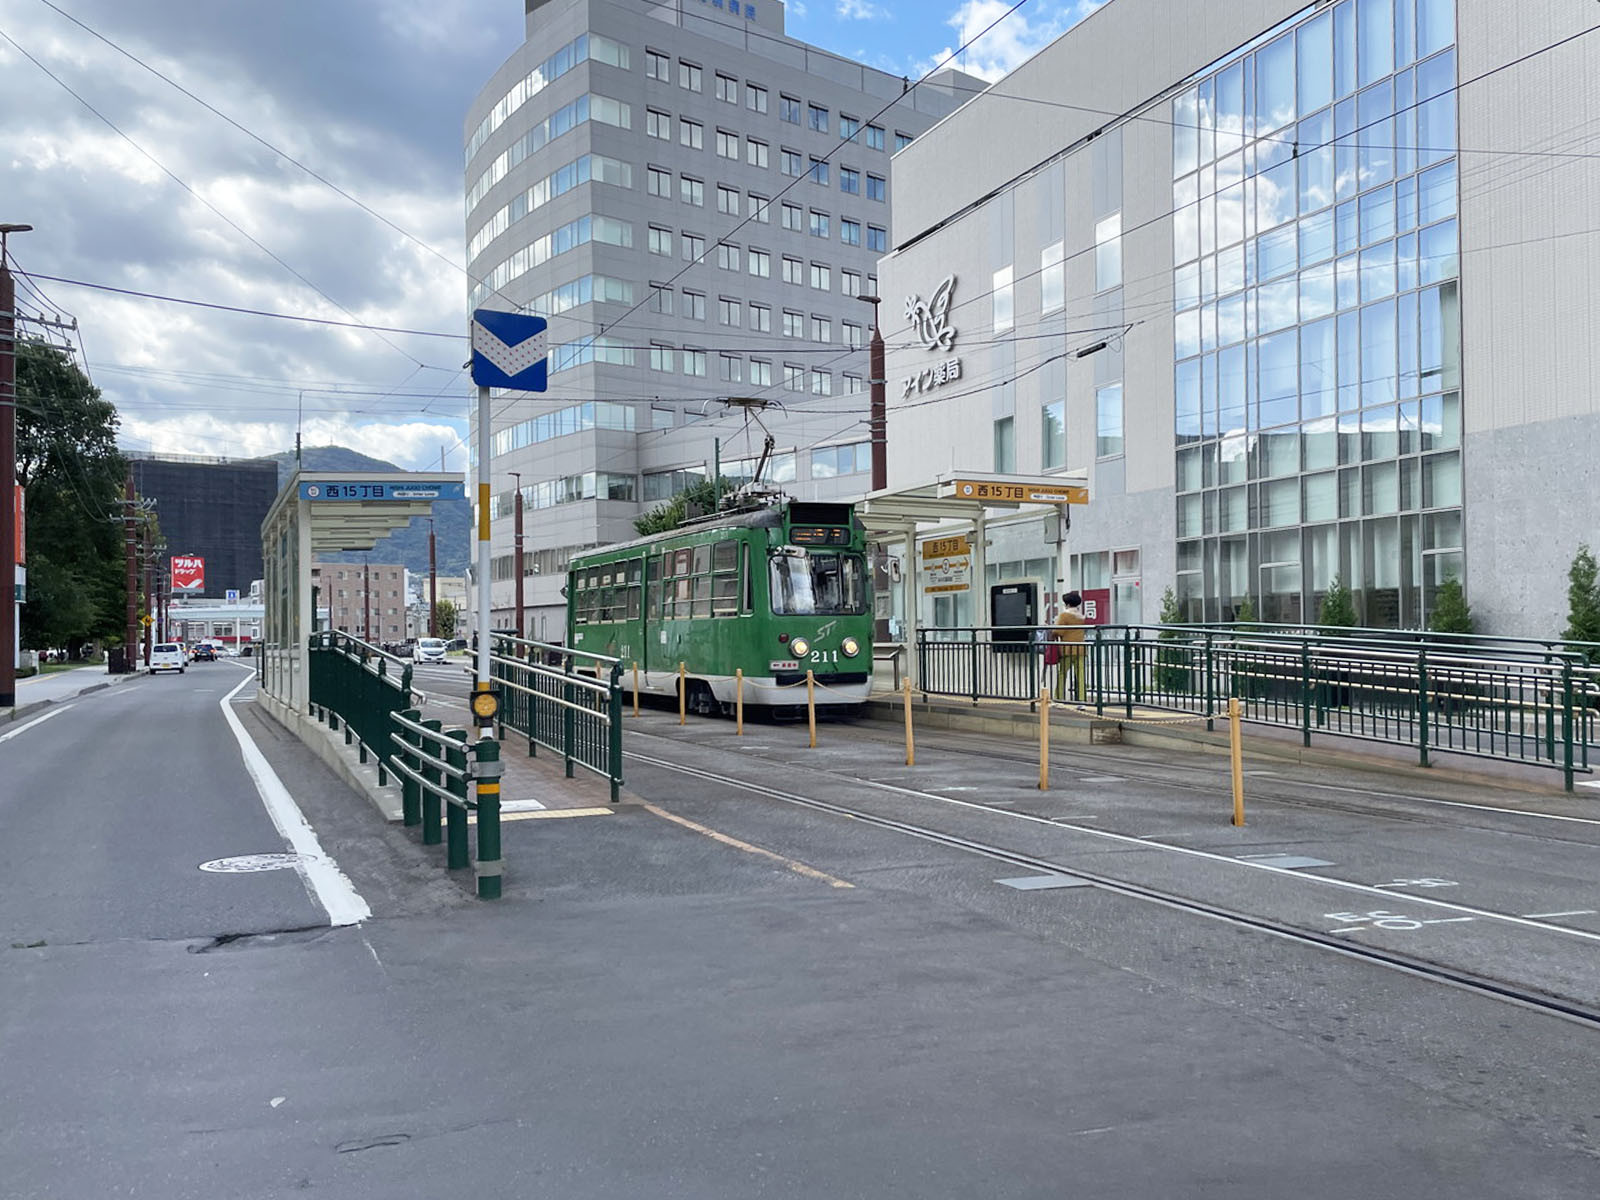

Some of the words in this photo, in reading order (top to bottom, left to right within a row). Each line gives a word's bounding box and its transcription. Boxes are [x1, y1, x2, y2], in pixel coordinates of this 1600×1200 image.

[326, 485, 384, 497] 西15丁目
[977, 484, 1023, 498] 西15丁目
[174, 559, 202, 568] ツルハ
[810, 650, 839, 663] 211
